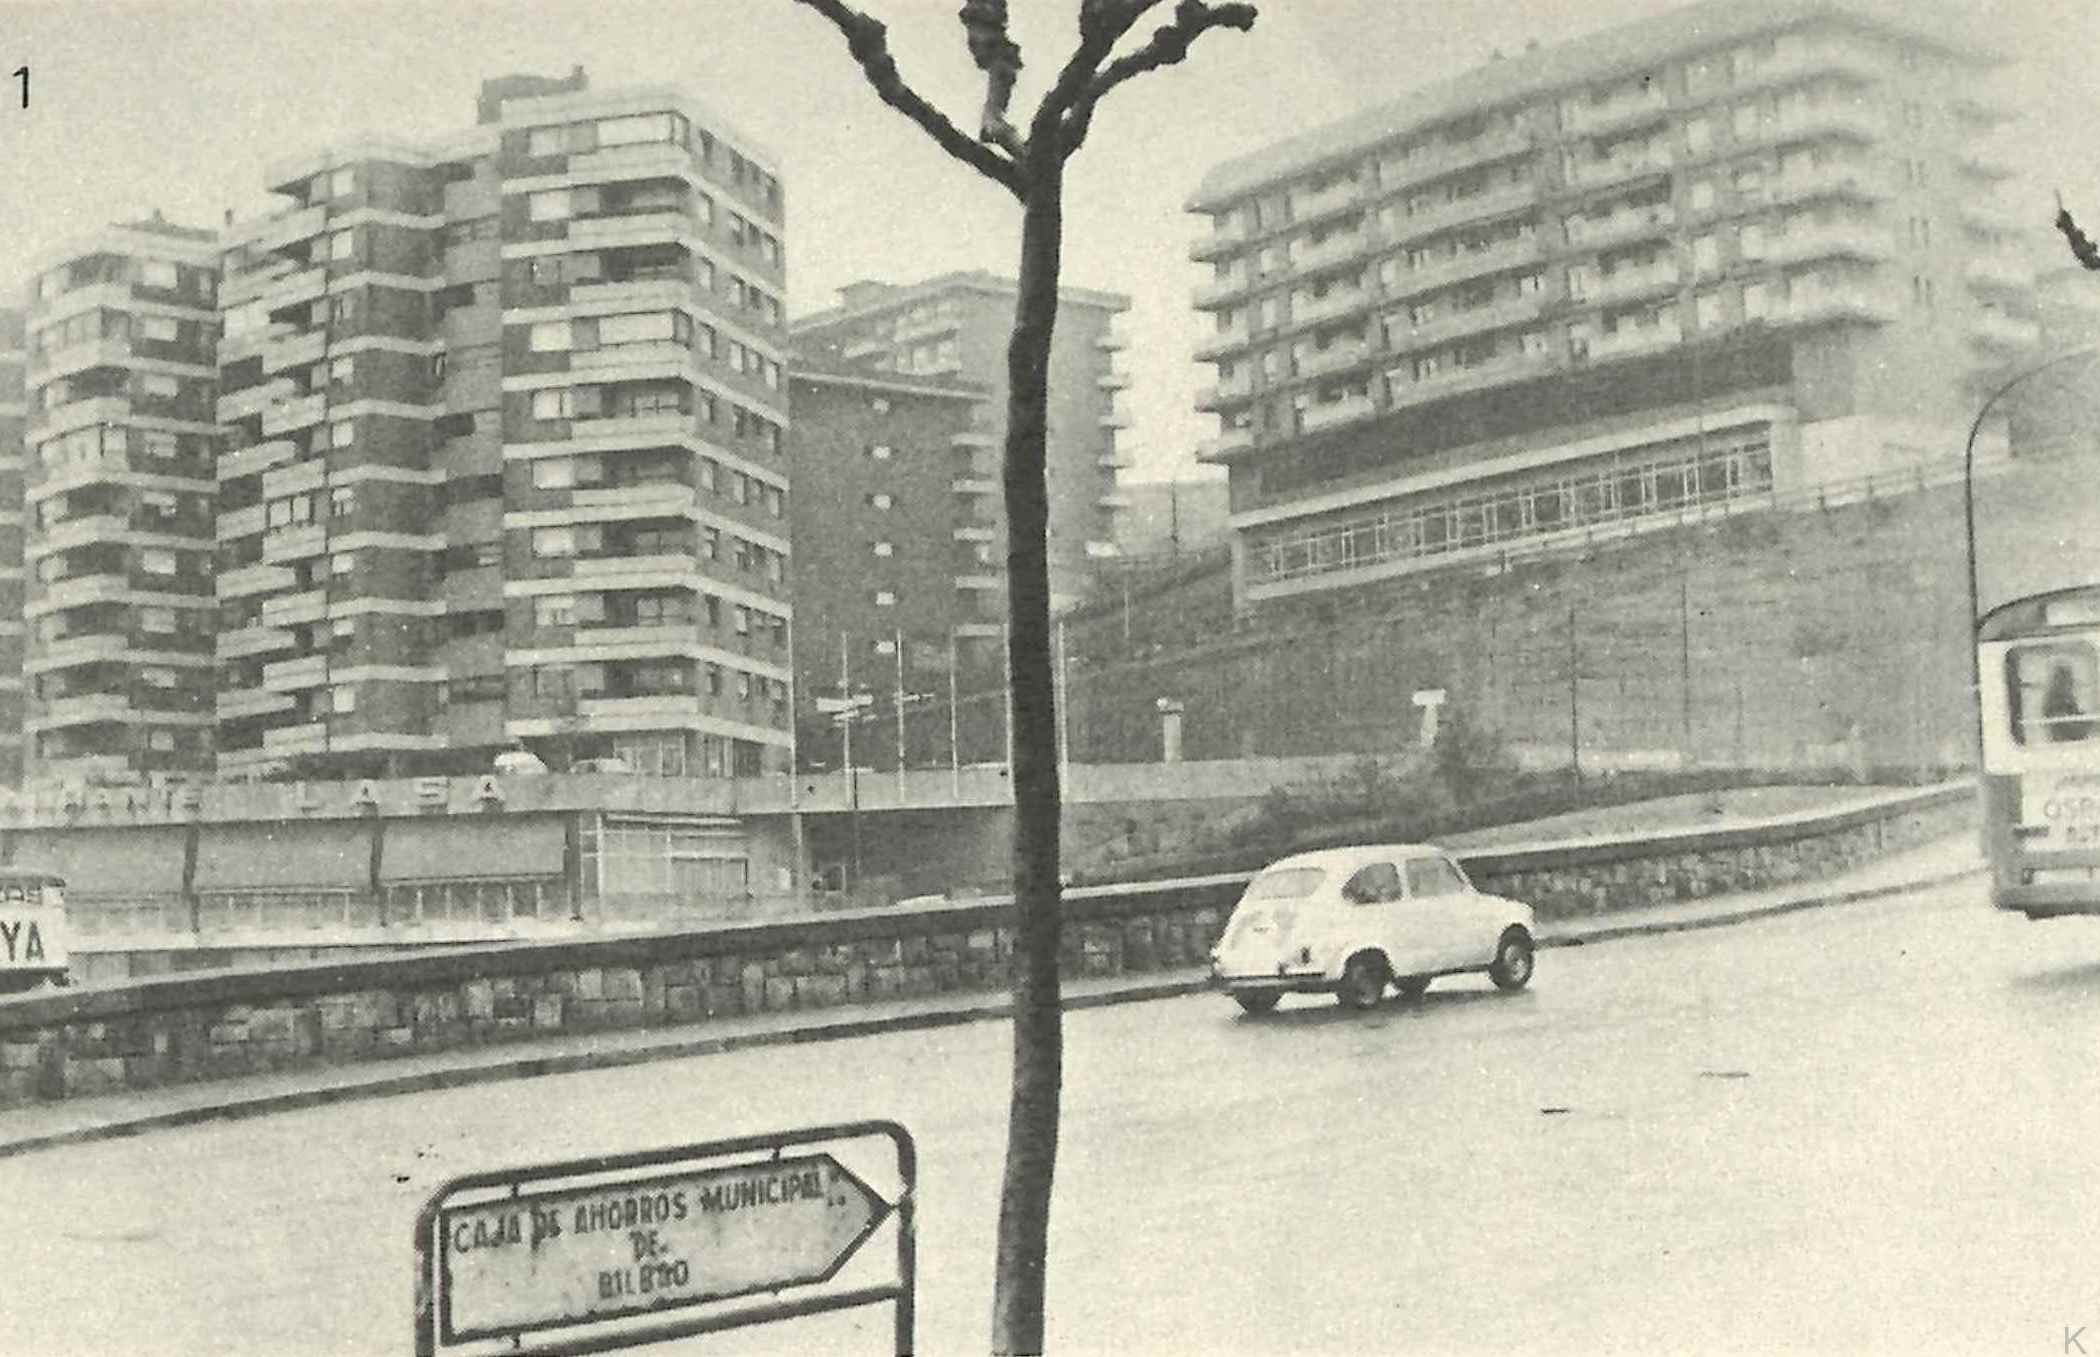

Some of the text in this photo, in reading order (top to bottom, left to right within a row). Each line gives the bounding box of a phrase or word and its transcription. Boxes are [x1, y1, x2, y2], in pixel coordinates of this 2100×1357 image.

[0, 920, 45, 962] YA
[454, 1213, 521, 1254] CAJA
[530, 1207, 562, 1246] DE
[574, 1191, 688, 1235] AHORROS
